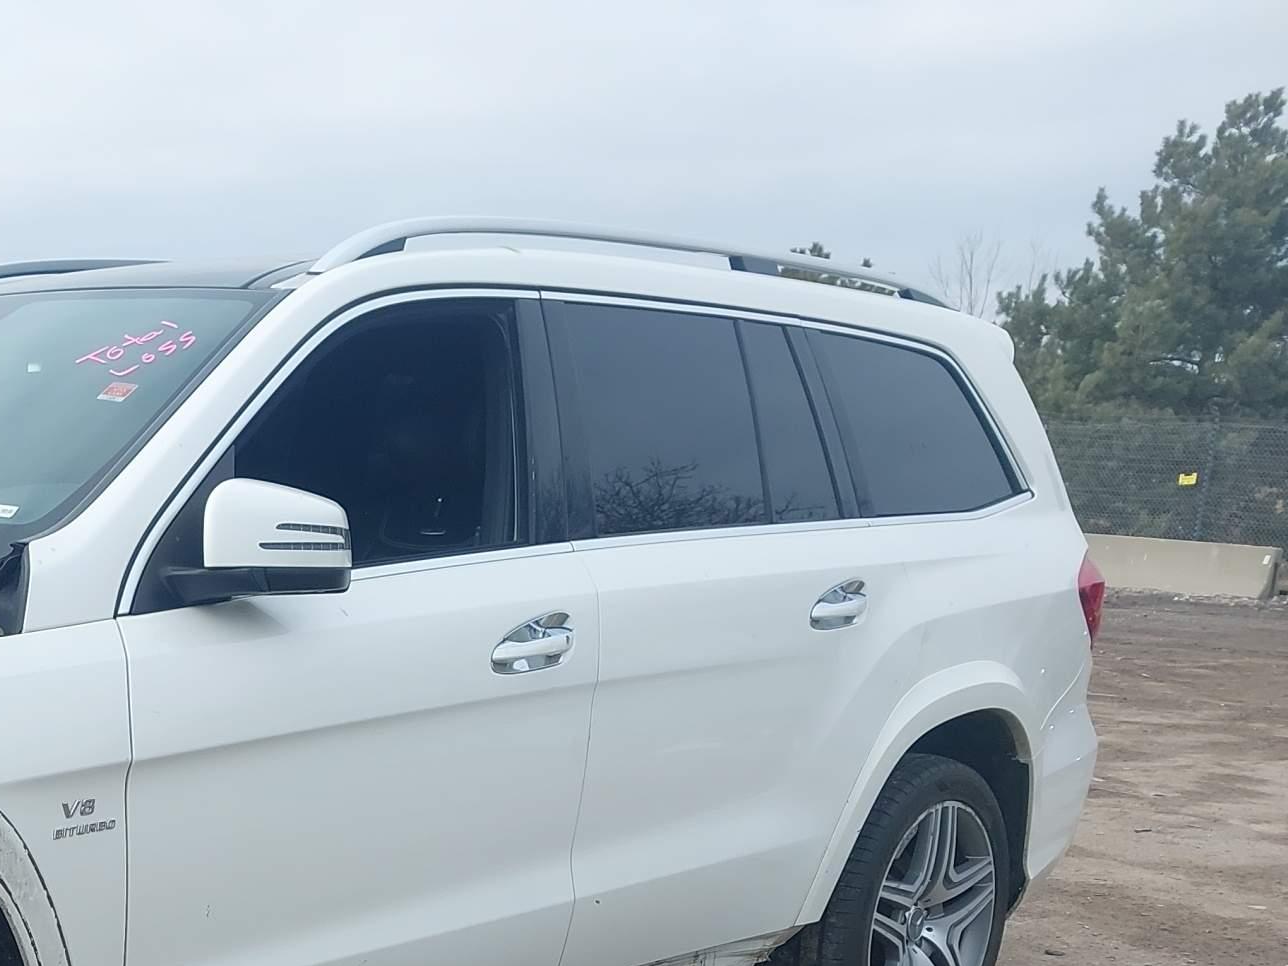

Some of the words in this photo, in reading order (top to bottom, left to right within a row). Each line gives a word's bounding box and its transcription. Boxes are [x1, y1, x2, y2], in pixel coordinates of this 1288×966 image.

[75, 321, 178, 365] Total
[61, 798, 97, 819] V8
[53, 819, 116, 840] BITURBO
